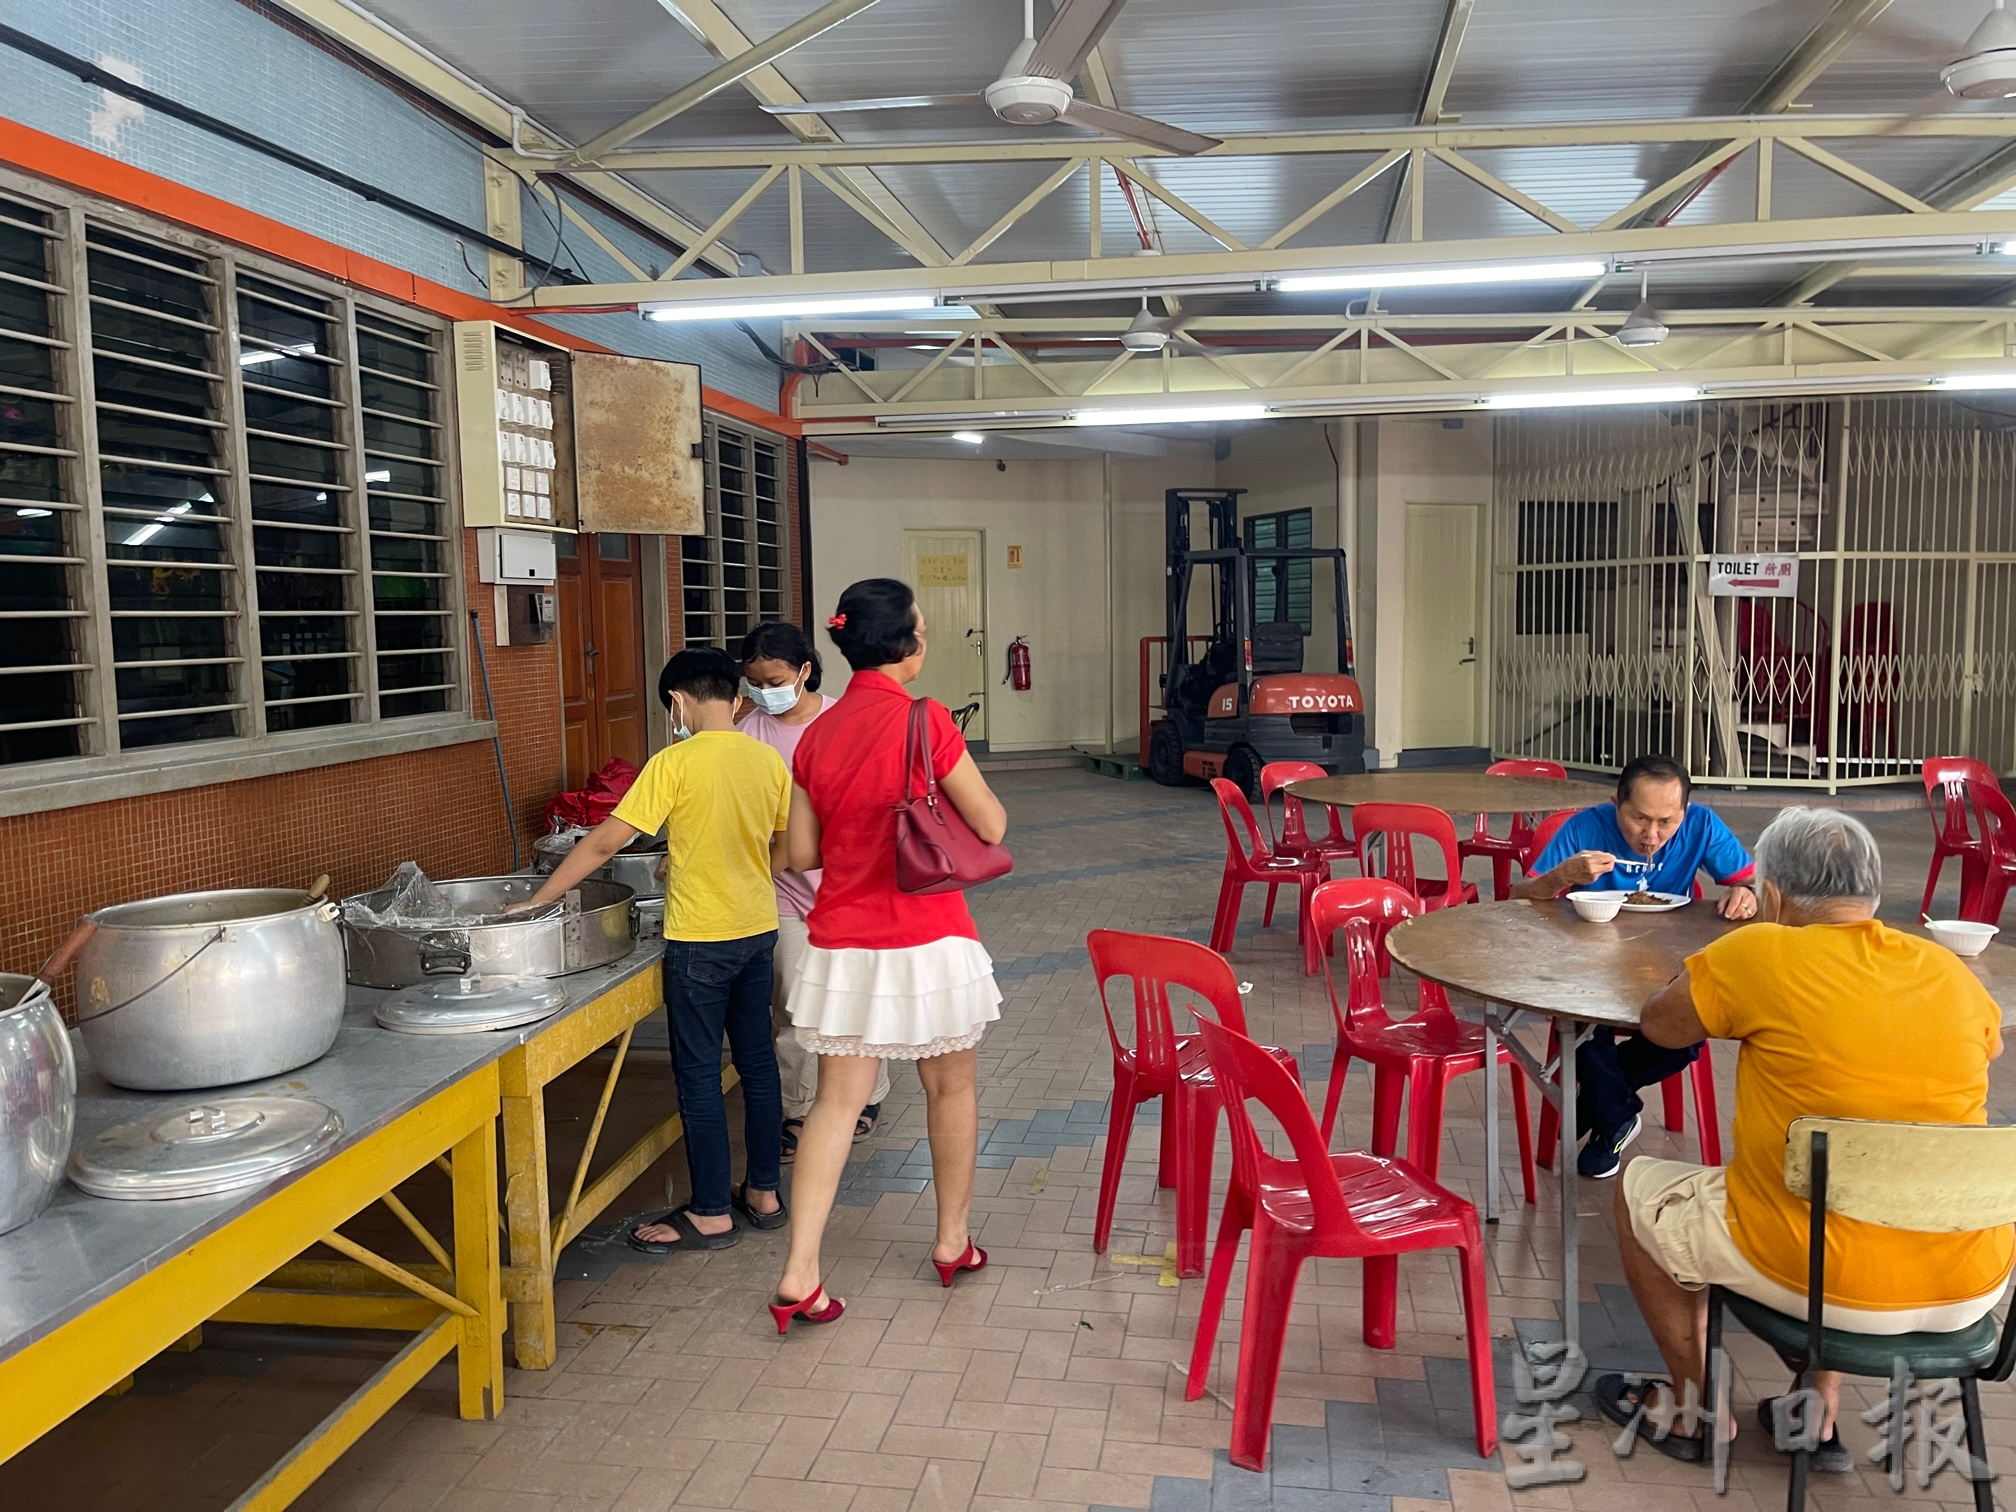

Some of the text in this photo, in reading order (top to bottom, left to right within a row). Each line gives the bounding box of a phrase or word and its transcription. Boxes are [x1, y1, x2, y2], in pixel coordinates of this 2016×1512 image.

[1717, 561, 1760, 576] TOILET
[1222, 697, 1233, 711] 15
[1288, 694, 1354, 709] TOYOTA
